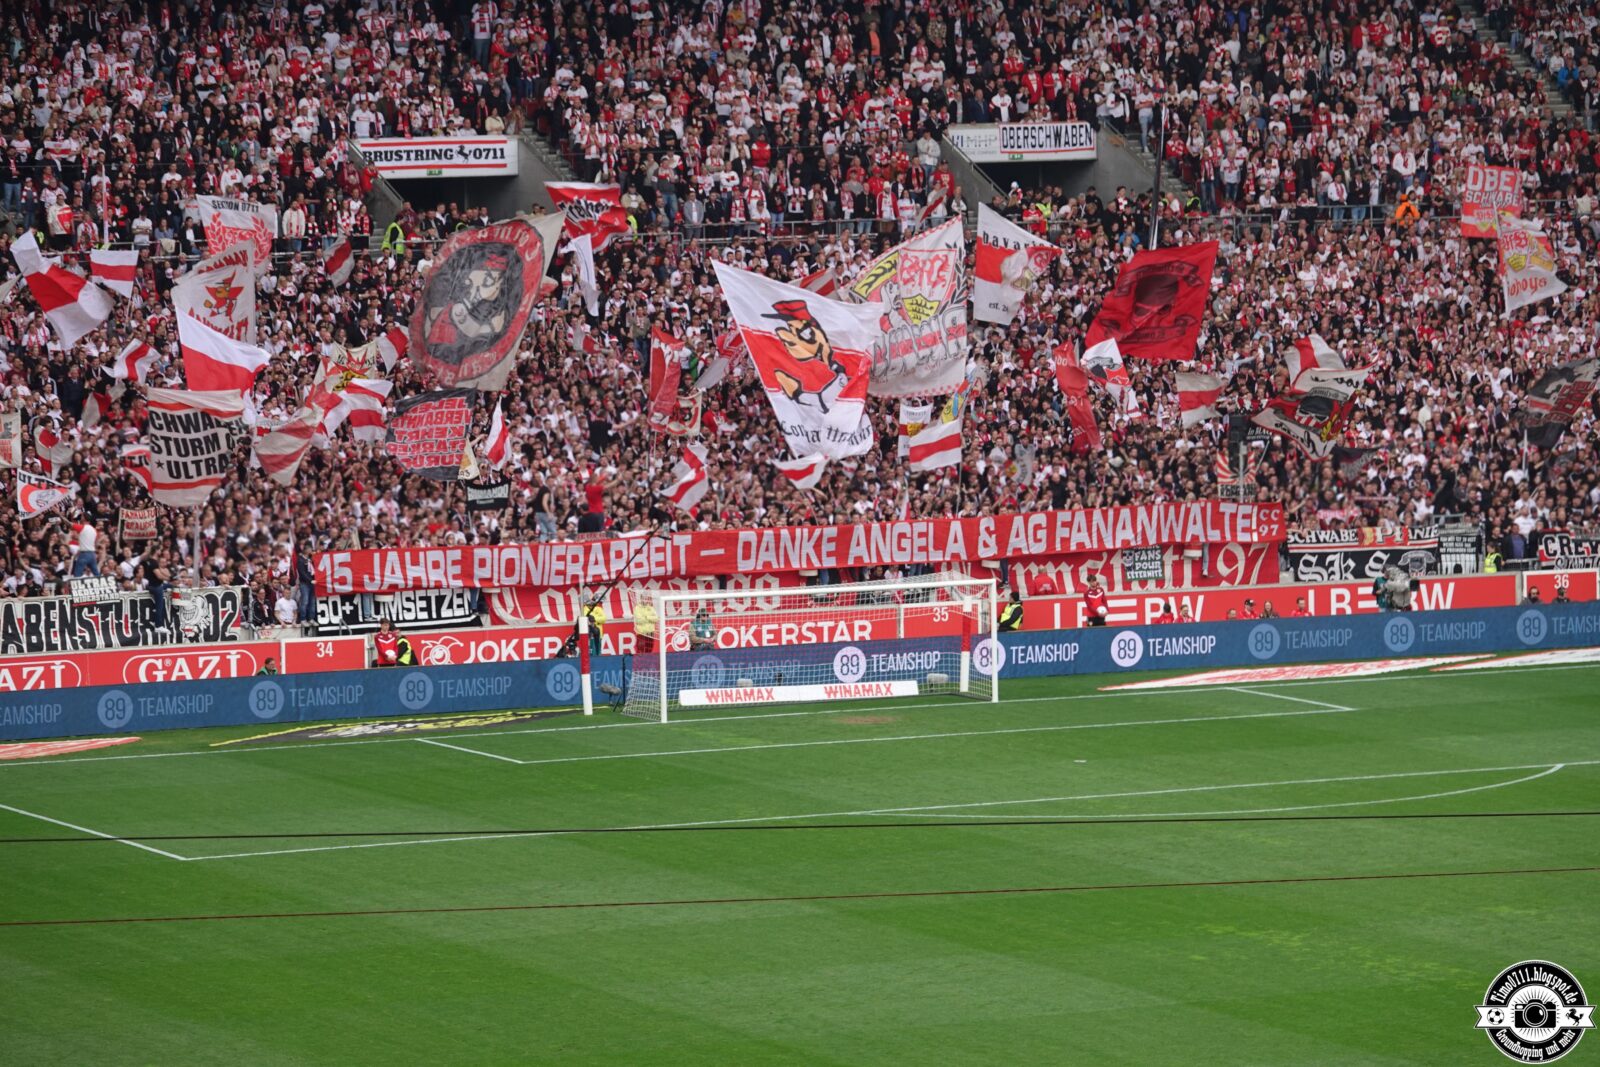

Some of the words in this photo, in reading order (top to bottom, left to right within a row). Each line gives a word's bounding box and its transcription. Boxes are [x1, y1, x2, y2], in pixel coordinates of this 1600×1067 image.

[1001, 124, 1093, 149] OBERSCHWABEN
[364, 149, 453, 162] BRUSTRING
[473, 148, 505, 160] 0711
[150, 432, 221, 457] STURM
[165, 453, 228, 479] ULTRA
[1258, 524, 1279, 536] 97
[317, 552, 353, 593] 15
[363, 549, 464, 591] JAHRE
[473, 534, 692, 588] PIONIERARBEIT
[737, 526, 838, 571] DANKE
[847, 520, 967, 566] ANGELA
[978, 516, 998, 558] &
[1007, 513, 1047, 555] AG
[1055, 502, 1257, 551] FANANWÄLTE!
[1135, 550, 1161, 561] FANS
[1135, 561, 1161, 570] POUR
[1215, 542, 1269, 586] 97
[70, 576, 116, 590] ULTRAS
[1554, 574, 1569, 589] 36
[203, 591, 240, 642] 02
[317, 594, 363, 625] 50+1
[933, 606, 949, 622] 35
[716, 620, 872, 649] OKERSTAR
[1390, 624, 1409, 645] 89
[1419, 621, 1486, 643] TEAMSHOP
[1522, 616, 1541, 638] 89
[316, 641, 333, 657] 34
[1117, 638, 1137, 660] 89
[1147, 635, 1217, 657] TEAMSHOP
[1254, 631, 1274, 653] 89
[1284, 628, 1353, 651] TEAMSHOP
[840, 654, 860, 676] 89
[871, 651, 941, 673] TEAMSHOP
[1010, 642, 1079, 665] TEAMSHOP
[405, 679, 427, 702] 89
[438, 676, 512, 699] TEAMSHOP
[552, 671, 574, 693] 89
[824, 683, 893, 699] WINAMAX
[256, 688, 277, 711] 89
[289, 684, 364, 708] TEAMSHOP
[705, 687, 774, 703] WINAMAX
[104, 698, 126, 721] 89
[138, 694, 214, 717] TEAMSHOP
